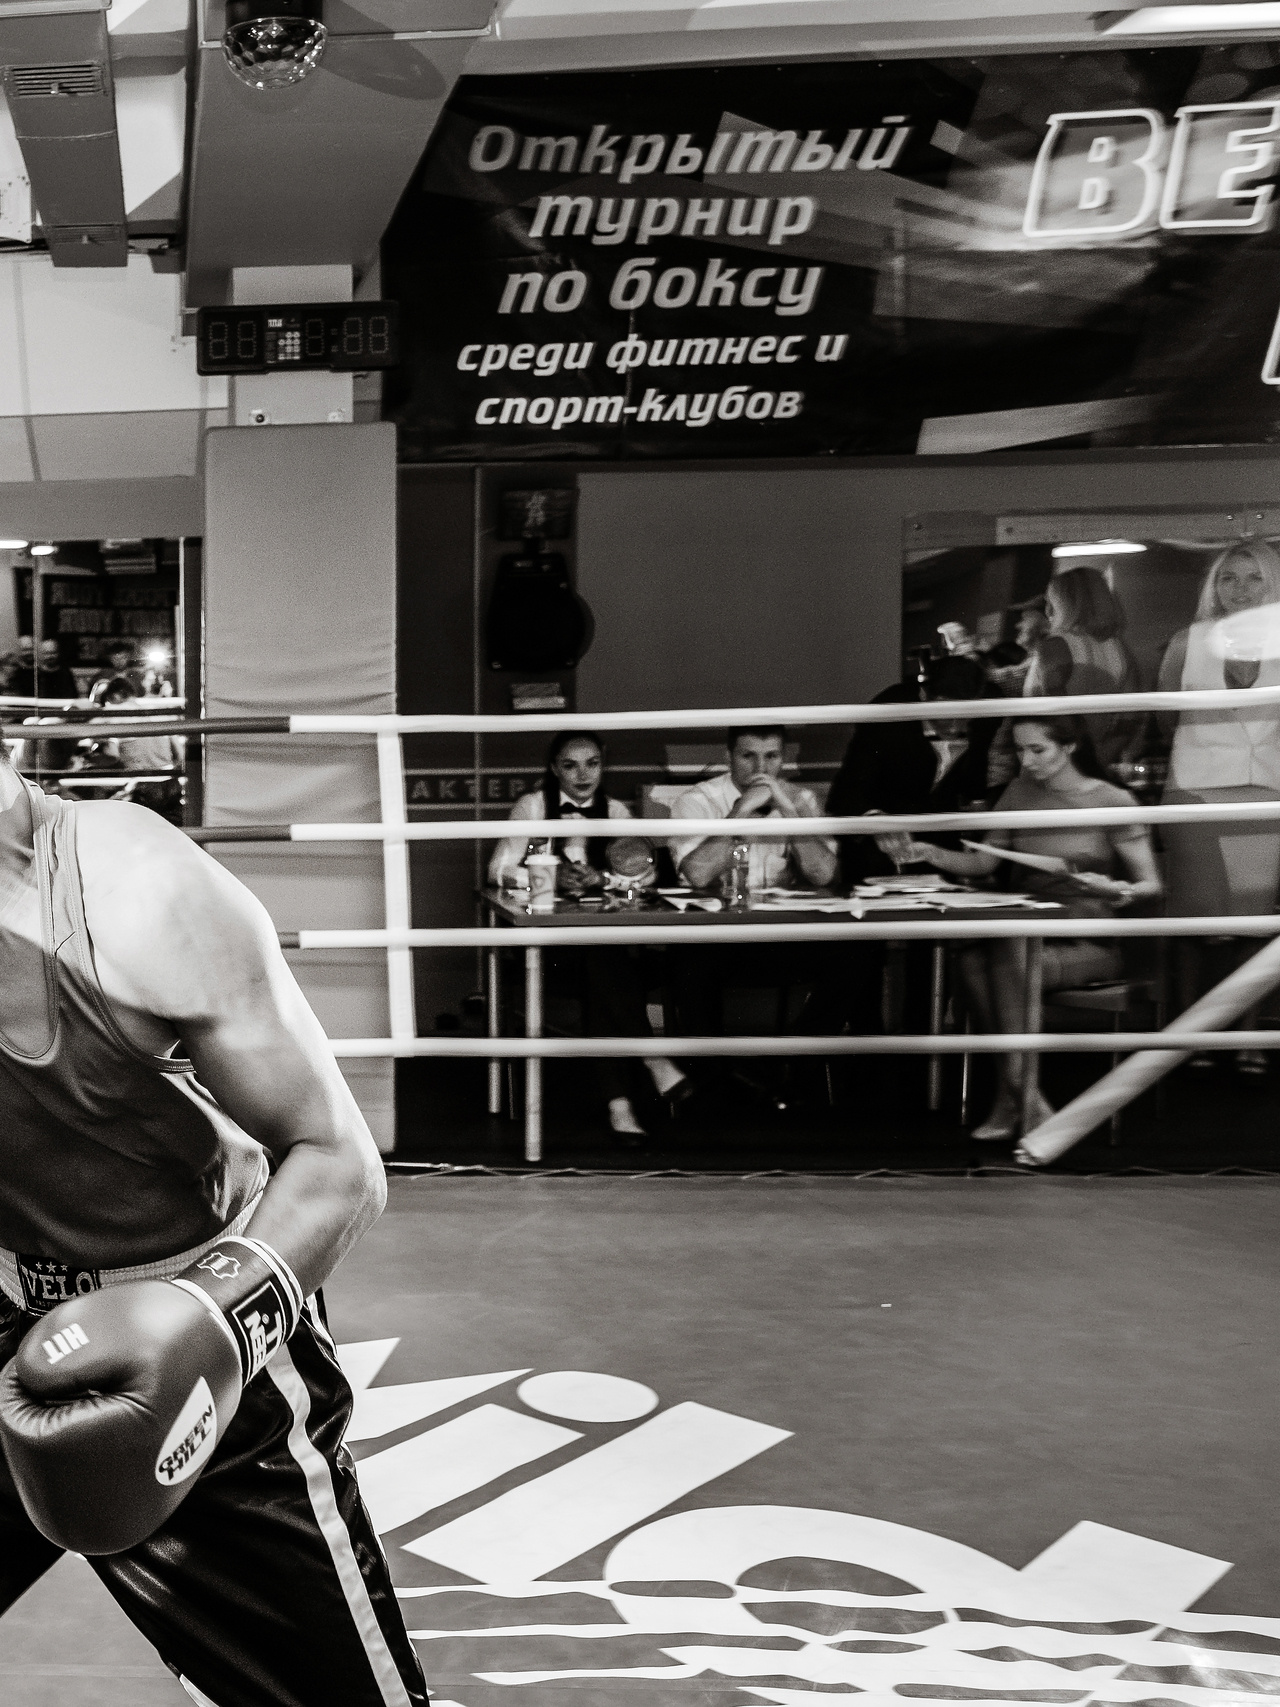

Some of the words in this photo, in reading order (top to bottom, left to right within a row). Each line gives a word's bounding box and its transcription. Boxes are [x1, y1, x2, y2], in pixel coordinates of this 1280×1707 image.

[468, 115, 914, 183] Открытый
[528, 194, 818, 246] турнир
[498, 269, 589, 315] по
[609, 257, 826, 316] боксу
[457, 338, 595, 378] среди
[605, 332, 804, 375] фитнес
[814, 333, 849, 363] и
[475, 385, 804, 430] спорт-клубов
[20, 1264, 96, 1301] VELO
[41, 1322, 90, 1365] HIT
[158, 1403, 213, 1473] GREEN
